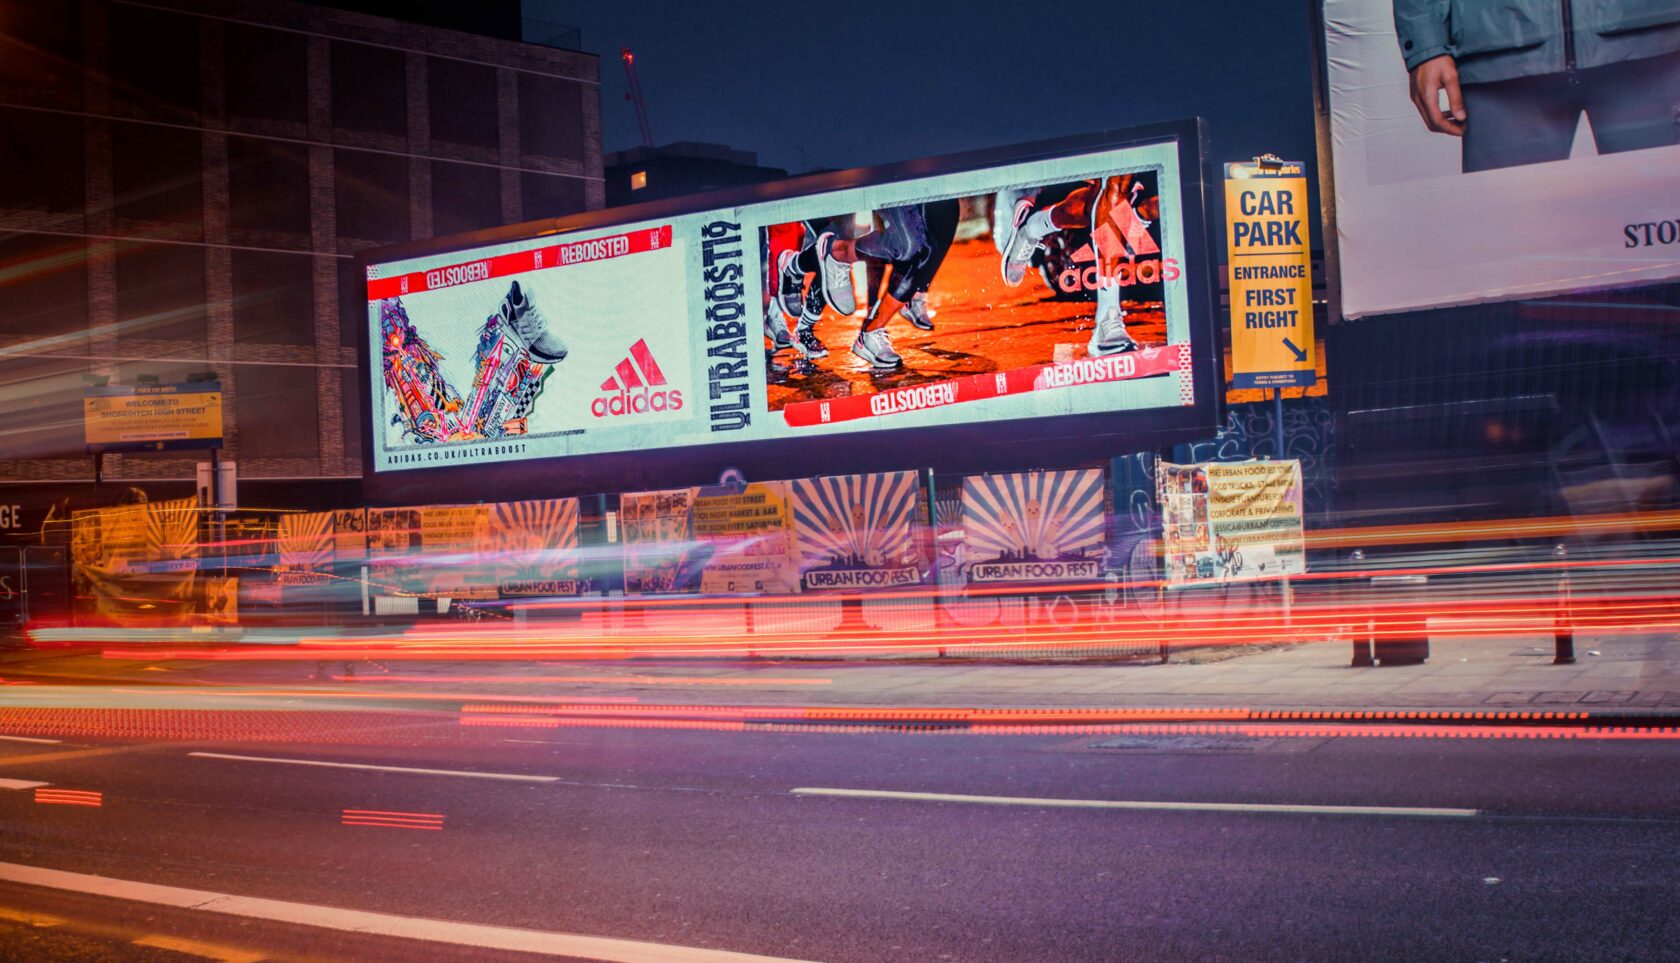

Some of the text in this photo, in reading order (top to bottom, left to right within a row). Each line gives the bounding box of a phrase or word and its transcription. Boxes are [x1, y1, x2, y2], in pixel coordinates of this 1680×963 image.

[1240, 190, 1293, 216] CAR
[1234, 220, 1302, 247] PARK
[1624, 219, 1680, 248] STO
[561, 236, 629, 264] REBOOSTED
[427, 261, 488, 289] REBOOSTED
[1059, 257, 1180, 293] adidas
[1234, 265, 1306, 280] ENTRANCE
[1246, 288, 1296, 306] FIRST
[1246, 310, 1298, 329] RIGHT
[1043, 355, 1135, 387] REBOOSTED
[125, 398, 179, 408] WELCOME TO
[591, 386, 683, 417] adidas
[871, 384, 954, 415] REBOOSTED
[101, 407, 206, 418] SHOREDITCH HIGH STREET
[388, 444, 526, 464] ADIDAS.CO.UK/ULTRABOOST
[1222, 468, 1243, 476] URBAN
[1244, 467, 1266, 475] FOOD
[743, 495, 765, 504] STREET
[729, 509, 753, 517] MARKET
[1210, 509, 1246, 518] CORPORATE
[744, 520, 782, 529] SATURDAY
[809, 568, 915, 586] URBAN FOOD FEST
[976, 563, 1094, 578] URBAN FOOD FEST
[504, 580, 574, 593] URBAN FOOD FEST
